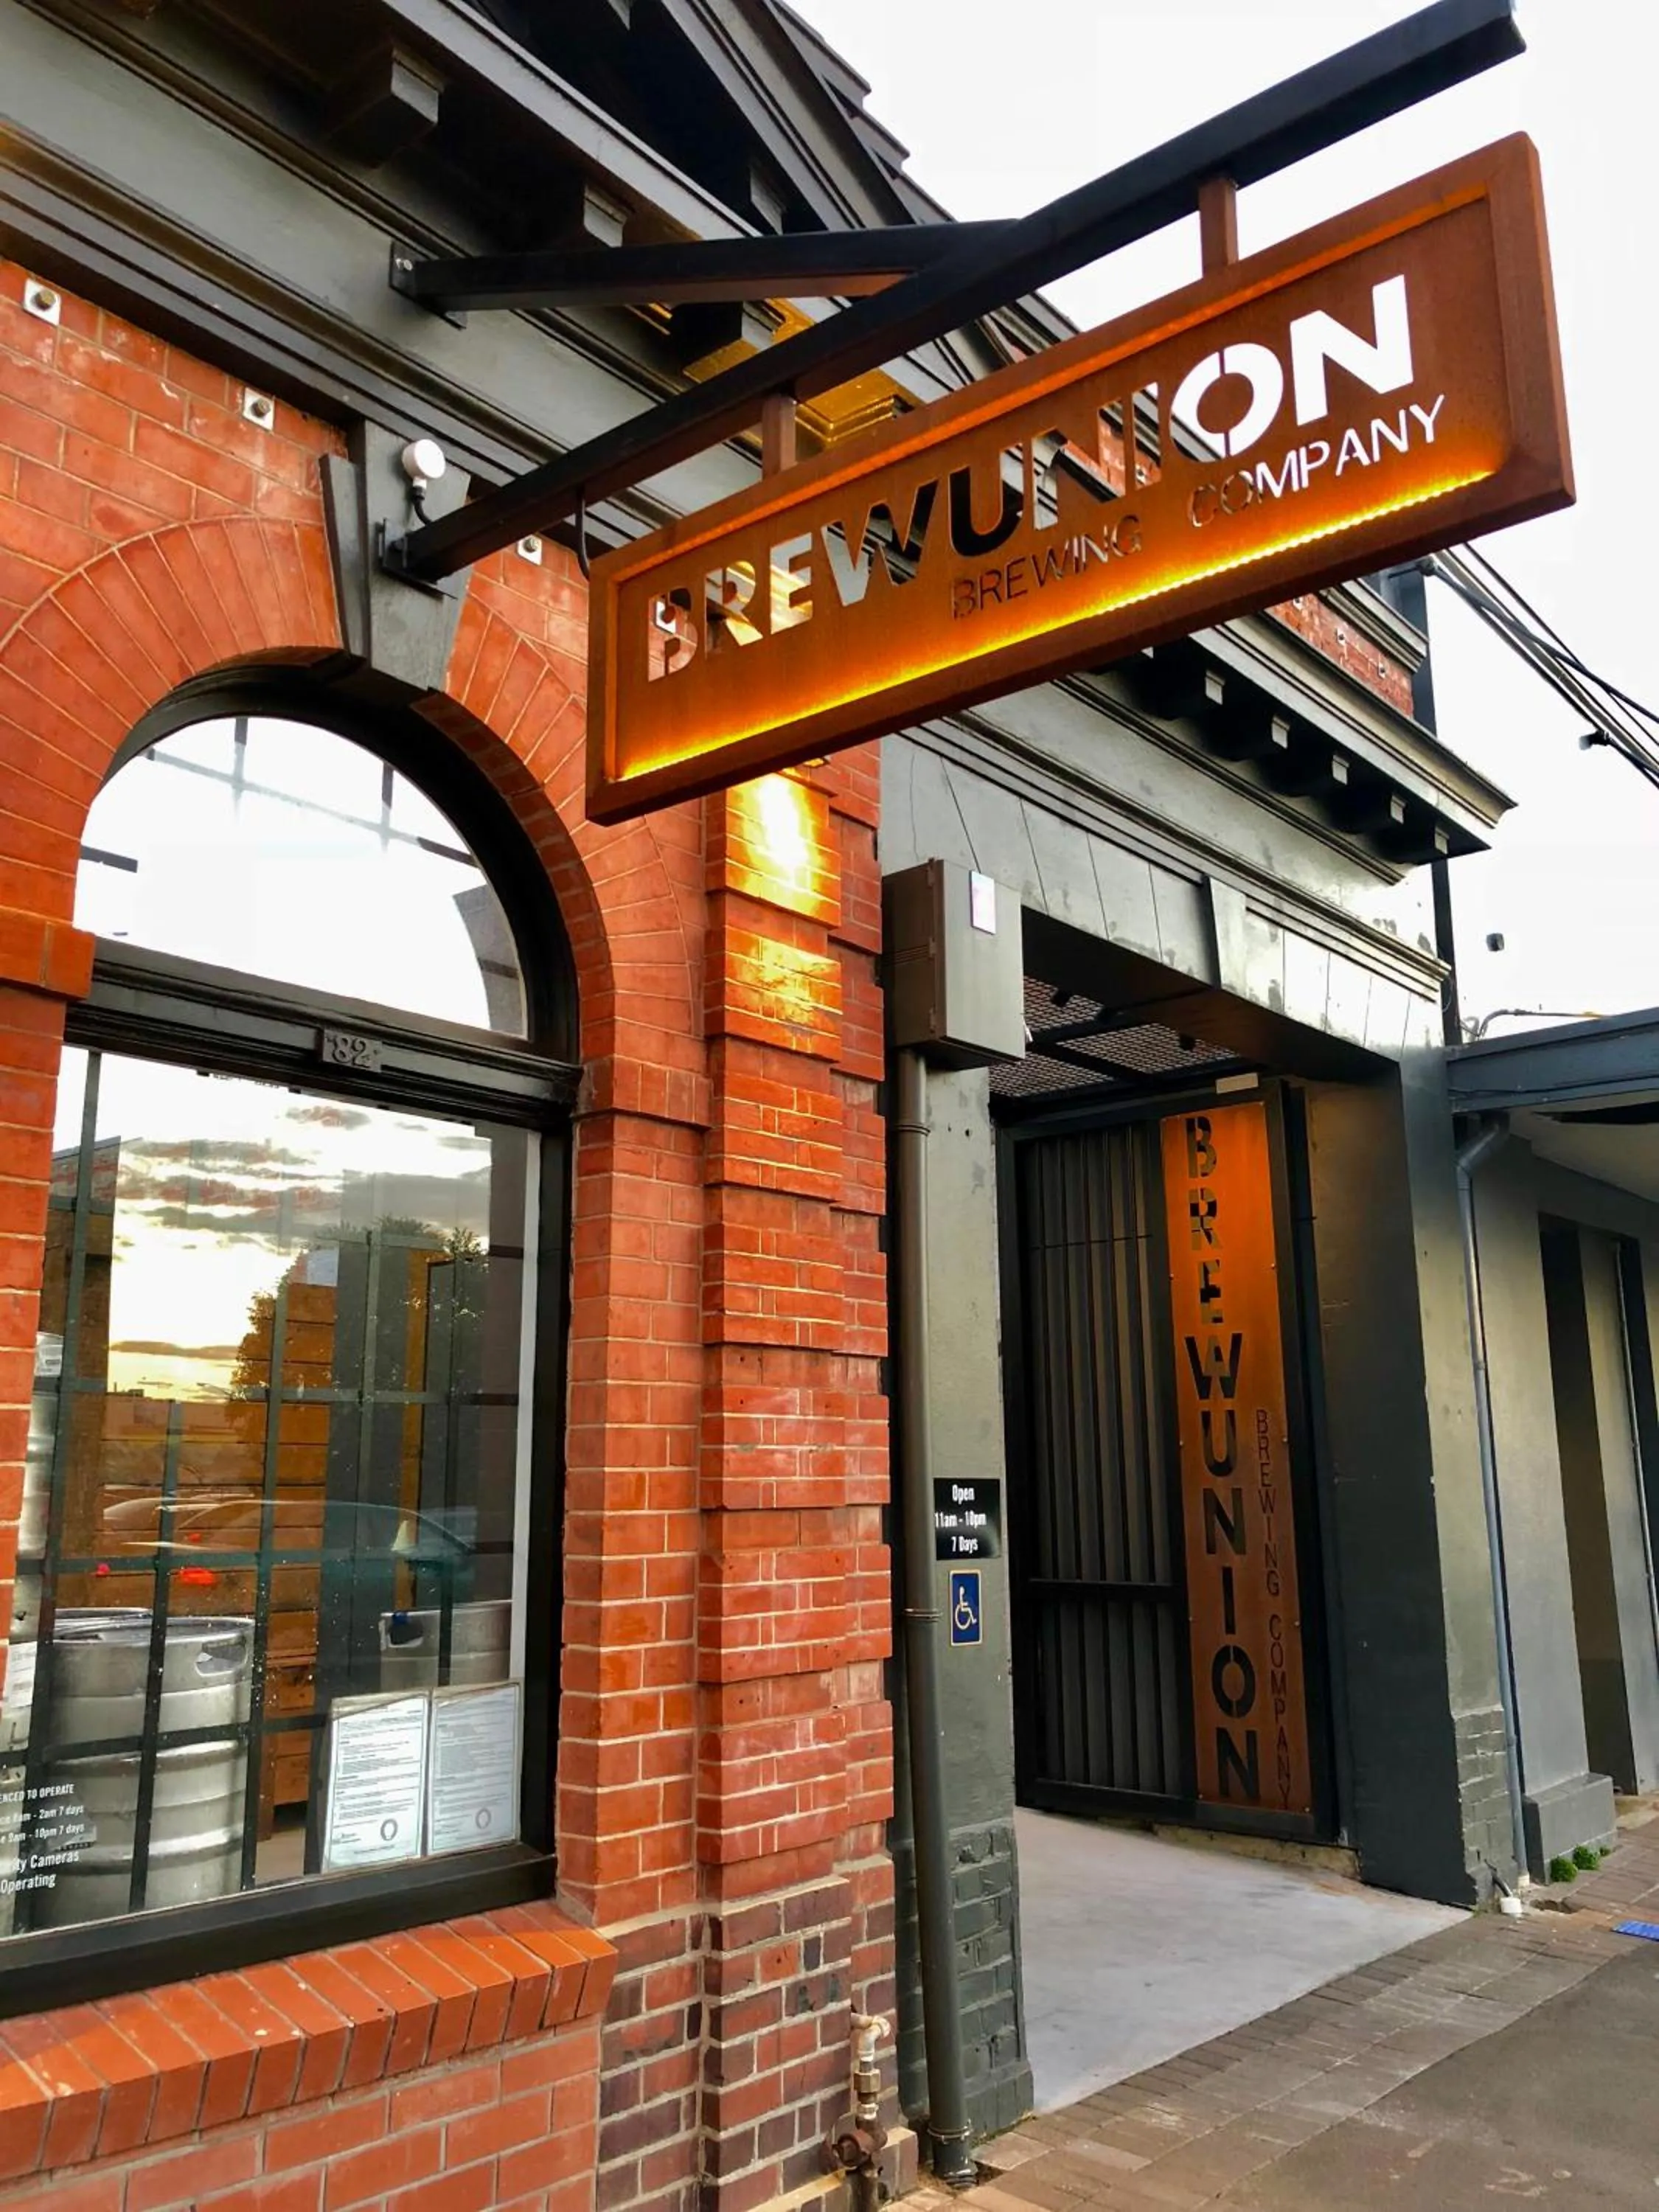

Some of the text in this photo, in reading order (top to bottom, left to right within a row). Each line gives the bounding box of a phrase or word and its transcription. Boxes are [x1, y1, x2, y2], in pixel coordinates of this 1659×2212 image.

[953, 394, 1445, 619] BREWING COMPANY
[331, 1036, 371, 1069] 82
[1184, 1116, 1262, 1800] BREWUNION
[952, 1484, 975, 1505] Open
[934, 1511, 958, 1528] 11am
[964, 1509, 987, 1528] 10pm
[950, 1536, 978, 1554] 7 Days
[1255, 1409, 1290, 1810] BREWING COMPANY
[27, 1789, 37, 1799] TO
[39, 1784, 74, 1798] OPERATE
[39, 1807, 57, 1819] 2am
[59, 1806, 64, 1816] 7
[66, 1804, 84, 1816] days
[35, 1826, 57, 1839] 10pm
[59, 1825, 64, 1834] 7
[66, 1823, 85, 1835] days
[30, 1851, 80, 1868] Cameras
[1, 1874, 56, 1895] Operating
